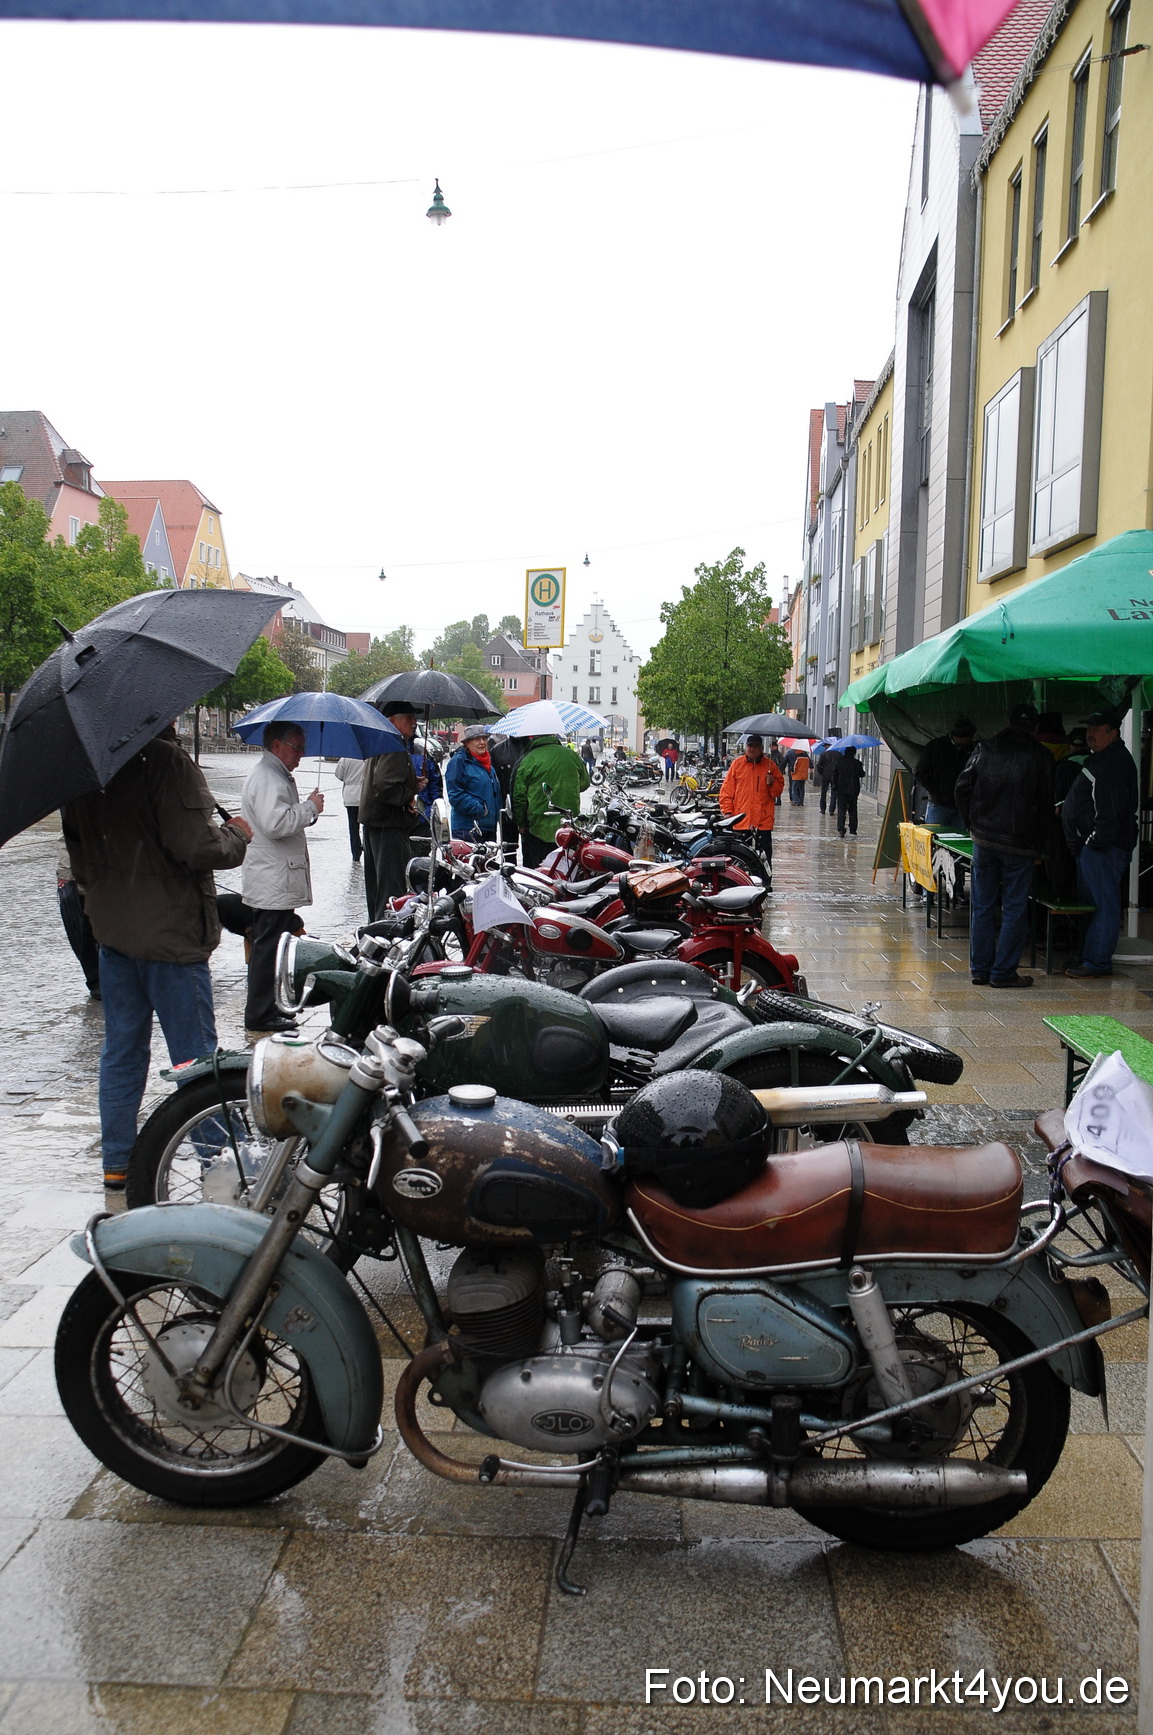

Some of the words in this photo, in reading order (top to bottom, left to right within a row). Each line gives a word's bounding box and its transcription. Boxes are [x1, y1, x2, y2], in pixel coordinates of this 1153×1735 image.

[539, 581, 551, 600] H
[1128, 598, 1153, 607] N
[1107, 608, 1153, 621] La
[543, 1416, 584, 1431] JLO
